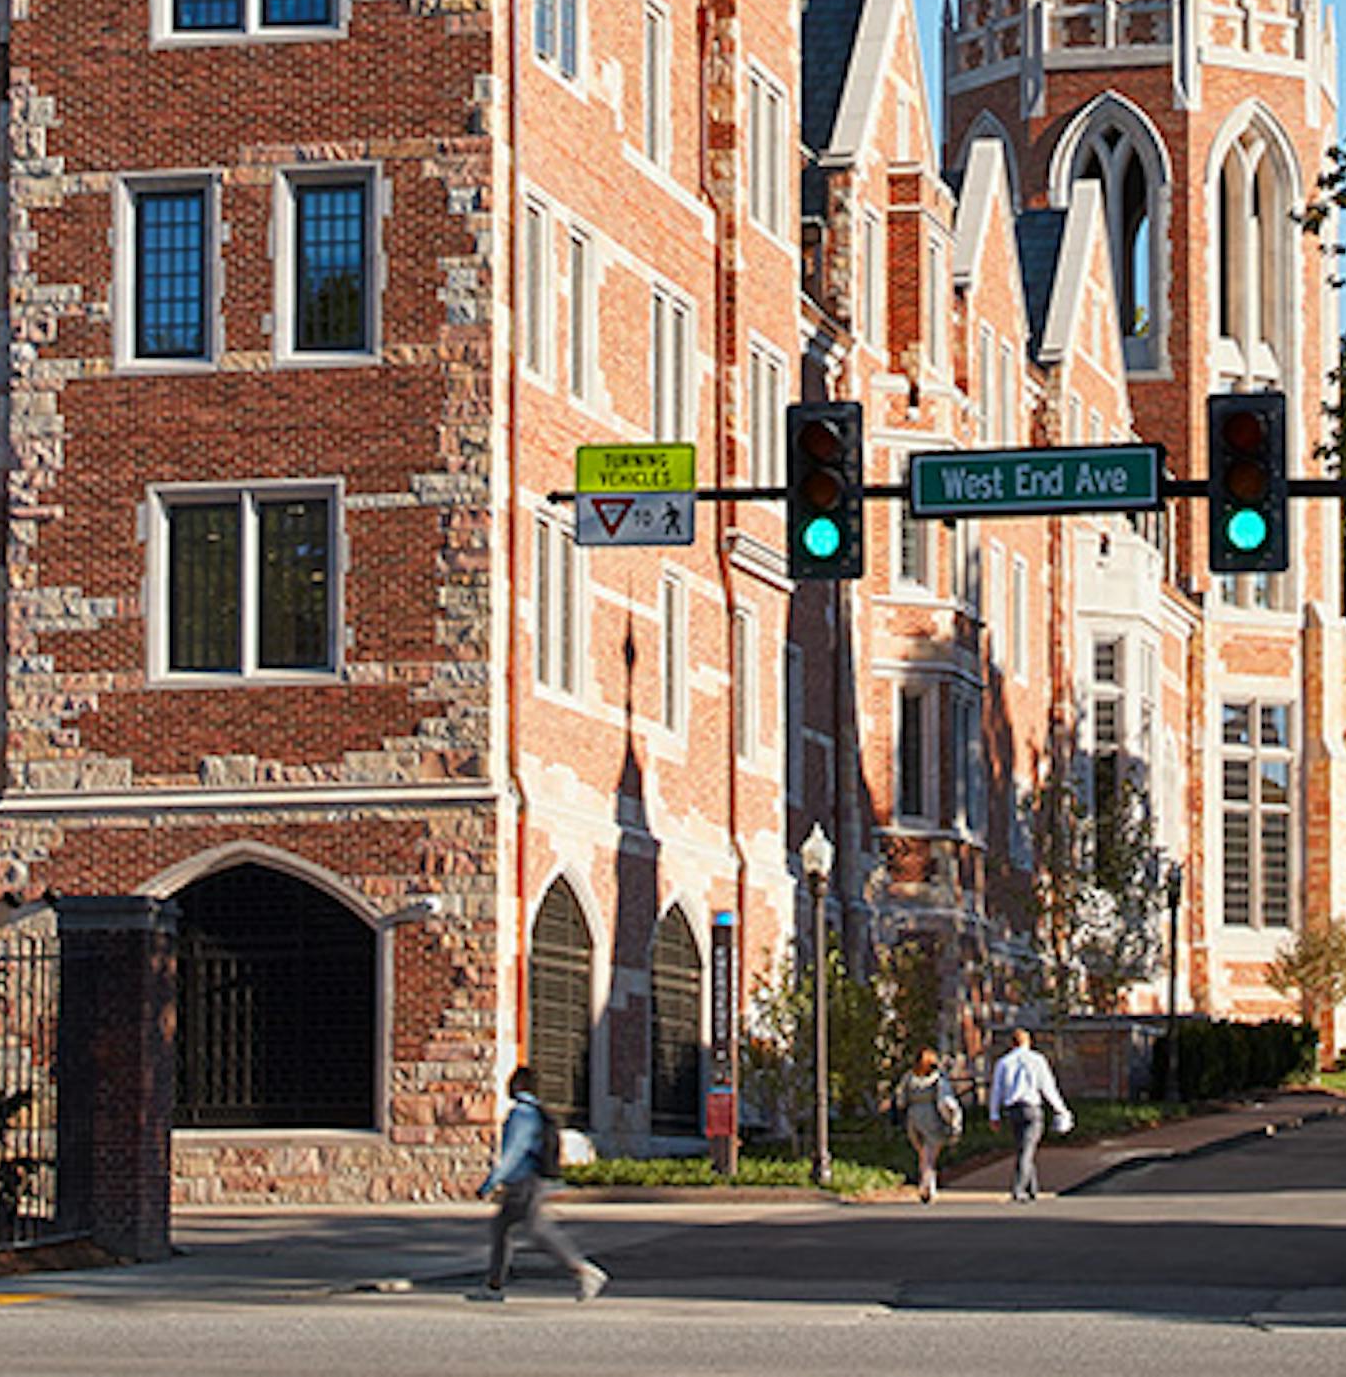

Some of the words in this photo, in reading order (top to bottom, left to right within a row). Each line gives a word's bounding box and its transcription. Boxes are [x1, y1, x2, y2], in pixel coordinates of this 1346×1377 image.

[604, 453, 667, 468] TURNING
[599, 471, 672, 487] VEHICLES
[941, 466, 1003, 500] West
[1014, 463, 1064, 497] End
[1075, 462, 1128, 494] Ave
